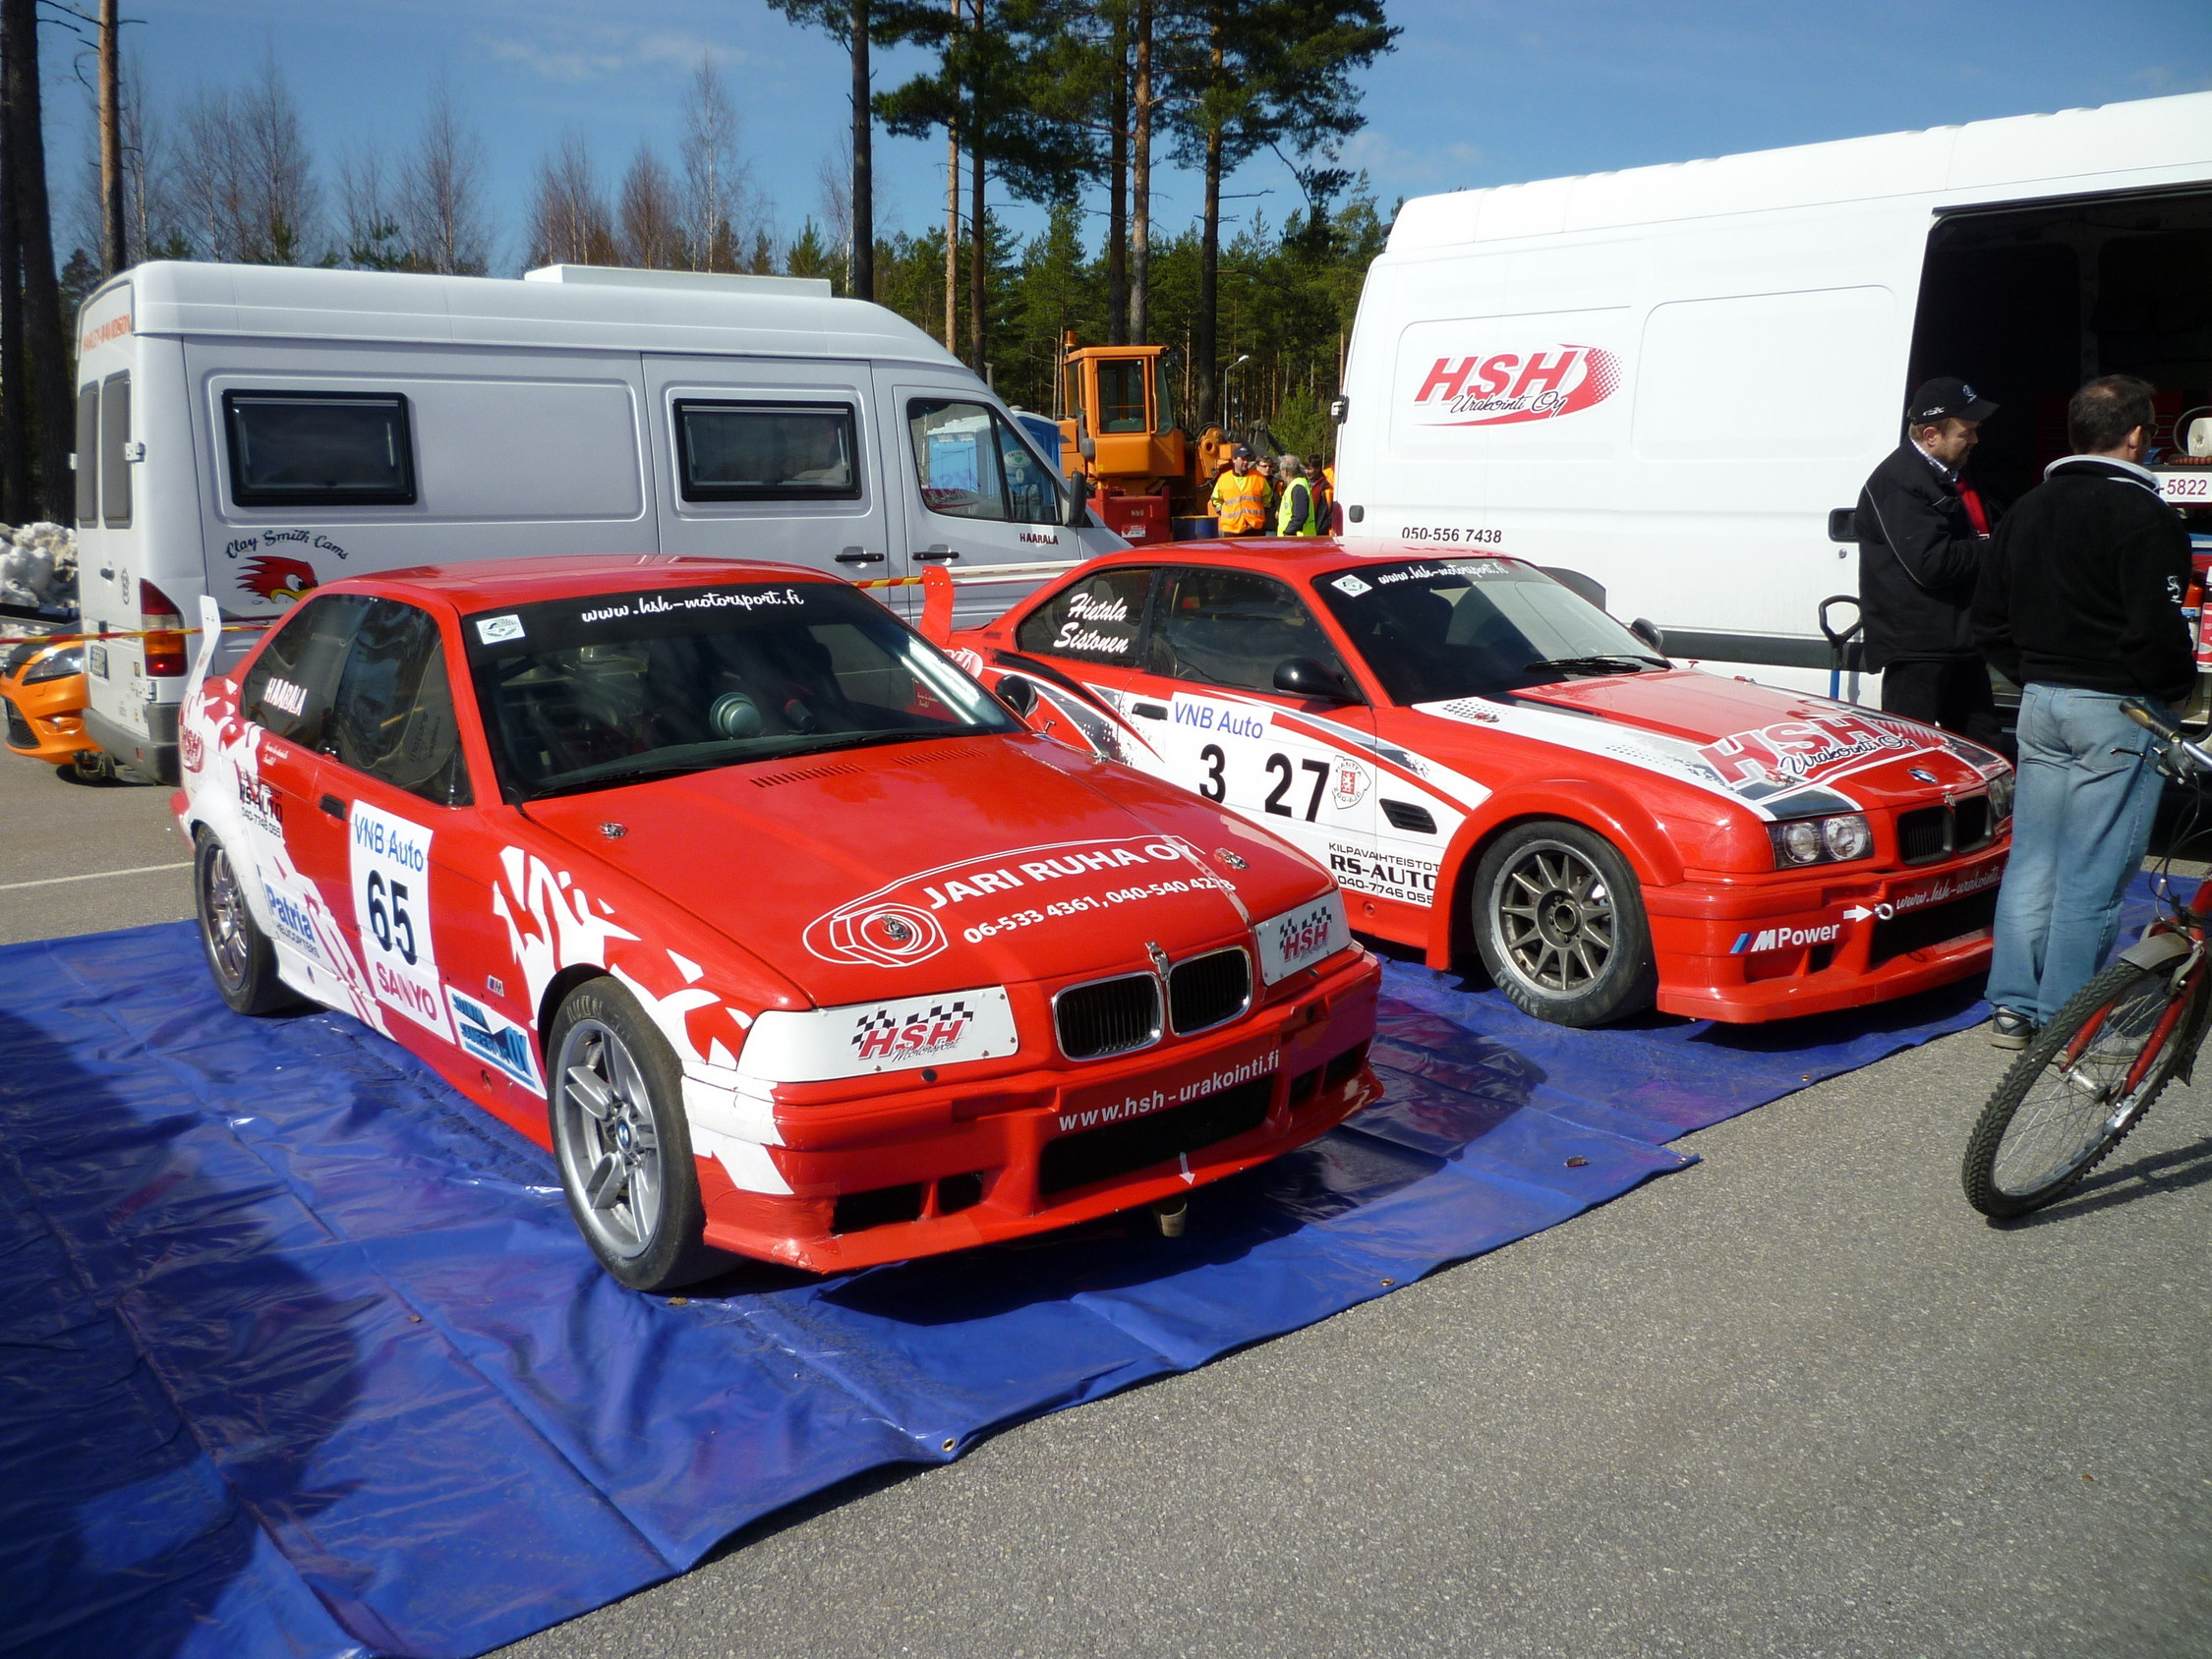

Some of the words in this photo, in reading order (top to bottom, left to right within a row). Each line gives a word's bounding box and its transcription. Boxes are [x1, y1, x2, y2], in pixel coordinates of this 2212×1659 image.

[1414, 350, 1578, 402] HSH
[1450, 394, 1530, 414] Urakointi
[1531, 390, 1566, 418] Oy
[225, 538, 258, 559] Clay
[262, 529, 311, 546] Smith
[313, 535, 350, 560] Cams
[1019, 532, 1060, 545] HAARALA
[1402, 527, 1460, 542] 050-556
[1465, 529, 1502, 543] 7438
[581, 589, 804, 623] www.hsh-motorsport.fi
[1067, 593, 1129, 621] Hietala
[1053, 621, 1130, 654] Sistonen
[1174, 702, 1214, 729] VNB
[1216, 711, 1264, 739] Auto
[1697, 717, 1884, 785] HSH
[1779, 739, 1875, 774] Urakointi
[1198, 743, 1226, 805] 3
[1265, 752, 1330, 823] 27
[354, 813, 384, 854] VNB
[388, 830, 425, 873] Auto
[1328, 841, 1441, 873] KILPAVAIHTEISTOT
[923, 869, 1024, 909] JARI
[1019, 847, 1149, 883] RUHA
[1144, 841, 1194, 861] OY
[1329, 853, 1437, 891] RS-AUTO
[1337, 875, 1404, 899] 040-7746
[1895, 865, 2006, 910] www.hsh-urakointi.
[263, 883, 316, 944] Patria
[368, 869, 417, 966] 65
[963, 908, 1044, 944] 06-533
[1283, 921, 1329, 960] HSH
[376, 960, 438, 1022] SANYO
[858, 1019, 964, 1059] HSH
[1058, 1049, 1280, 1132] www.hsh-urakointi.fi
